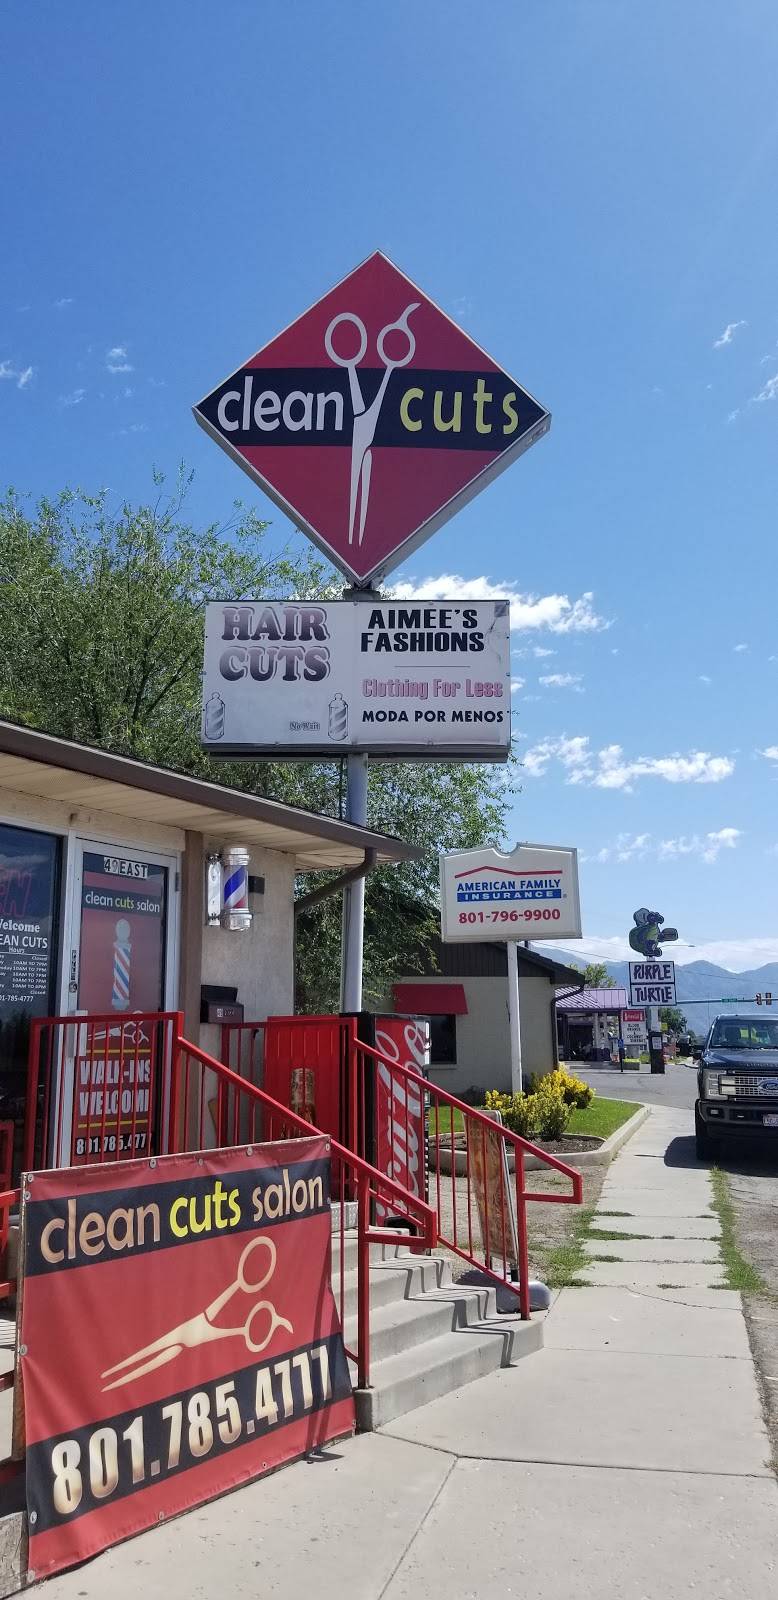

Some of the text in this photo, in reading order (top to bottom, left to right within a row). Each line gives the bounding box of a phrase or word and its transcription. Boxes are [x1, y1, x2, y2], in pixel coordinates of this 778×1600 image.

[218, 376, 519, 435] clean cuts
[221, 606, 330, 641] HAIR
[368, 609, 478, 630] AIMEE'S
[361, 632, 485, 652] FASHIONS
[219, 646, 332, 682] CUTS
[362, 679, 503, 700] Clothing For Less
[362, 710, 504, 723] MODA POR MENOS
[457, 879, 561, 892] AMERICAN FAMILY
[464, 890, 554, 901] INSURANCE
[85, 891, 160, 912] clean cuts salon
[458, 908, 561, 924] 801-796-9900
[22, 936, 48, 949] CUTS
[633, 964, 671, 981] PURPLE
[635, 986, 673, 1002] TURTLE
[40, 1170, 323, 1263] clean cuts salon
[51, 1344, 330, 1515] 801.785.4777
